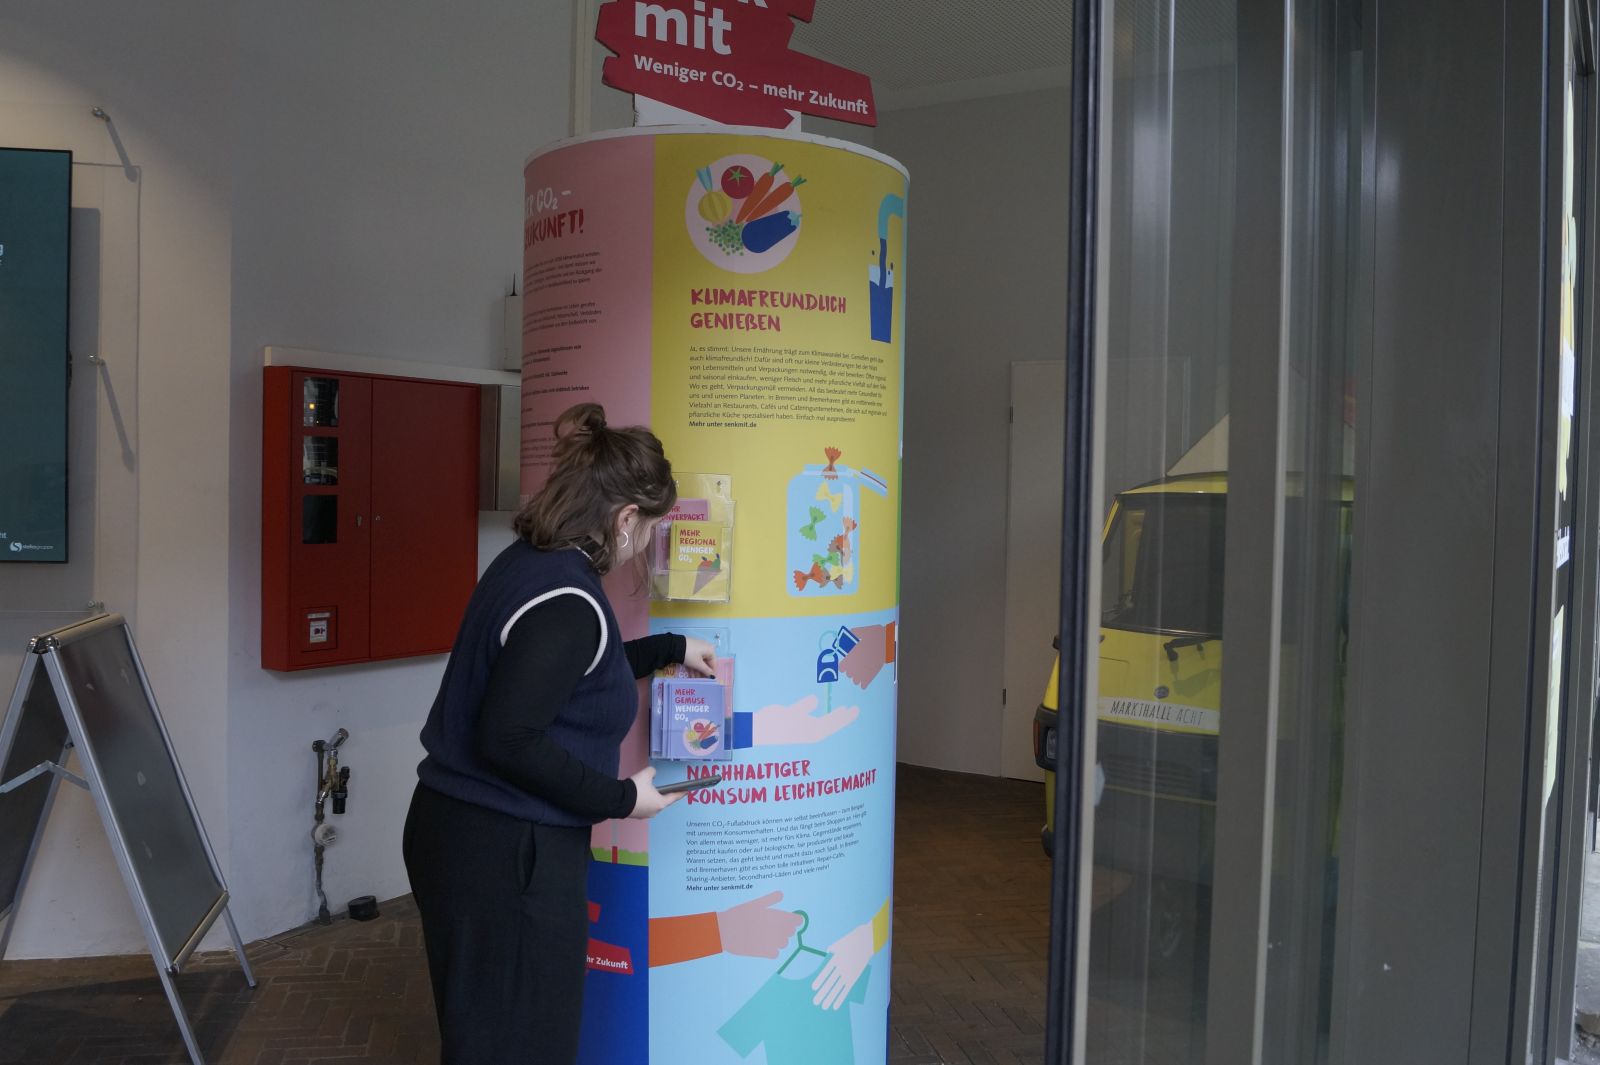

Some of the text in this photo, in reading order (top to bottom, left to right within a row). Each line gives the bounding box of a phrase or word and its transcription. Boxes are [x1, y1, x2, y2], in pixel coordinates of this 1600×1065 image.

[634, 0, 732, 55] mit
[634, 54, 706, 83] Weniger
[763, 82, 804, 101] mehr
[809, 90, 868, 115] Zukunft
[524, 208, 584, 248] UKUNFT!
[691, 288, 846, 314] KLIMAFREUNDLICH
[754, 347, 782, 355] Ernährung
[758, 365, 798, 374] Verpackungen
[679, 546, 714, 554] WENIGER
[1110, 700, 1203, 726] MARKTHALLE ACHT
[687, 760, 810, 781] NACHHALTIGER
[687, 769, 876, 805] KONSUM LEICHTGEMACHT
[739, 865, 750, 873] gibt
[740, 855, 754, 864] geht
[596, 957, 628, 969] Zukunft
